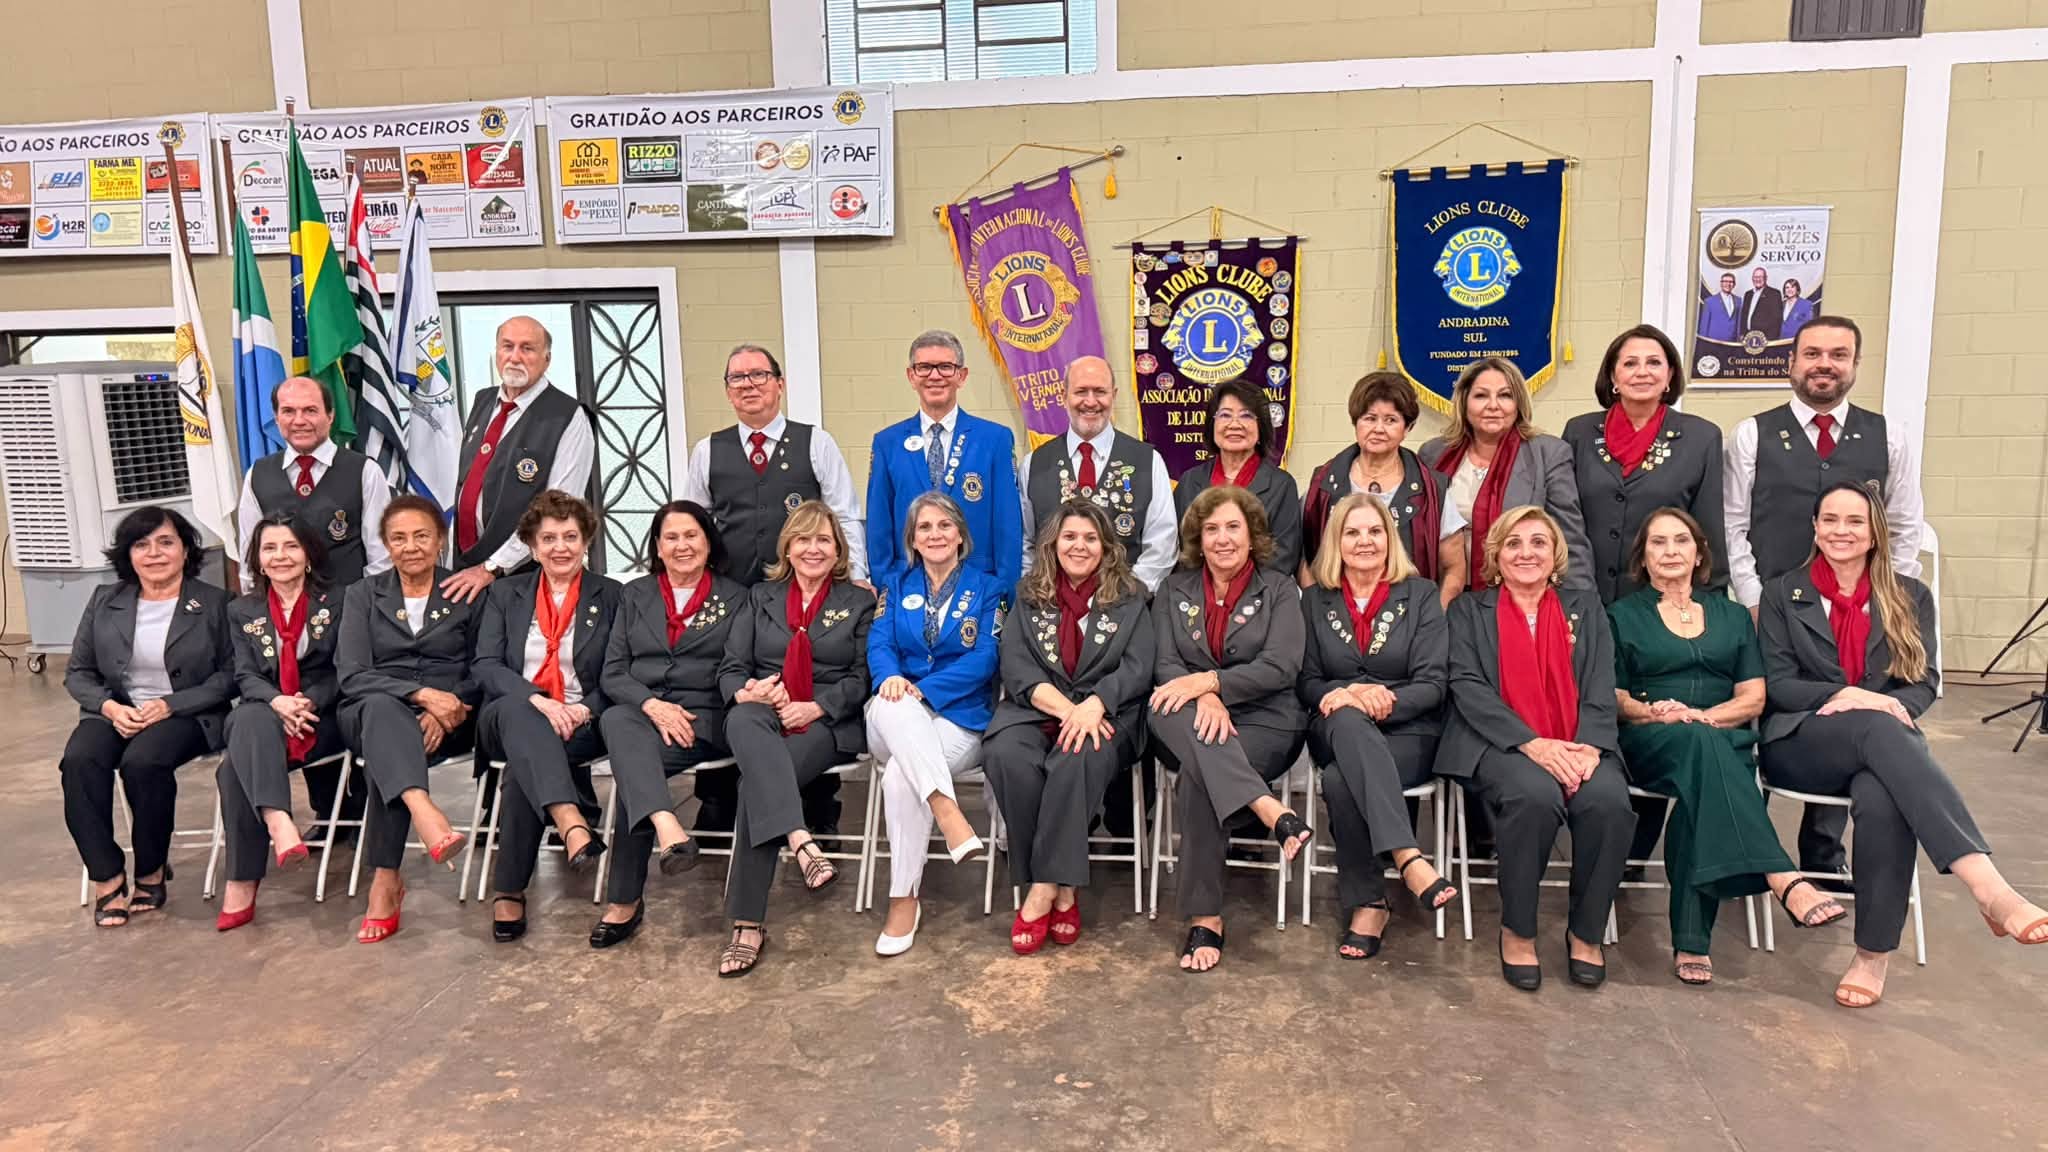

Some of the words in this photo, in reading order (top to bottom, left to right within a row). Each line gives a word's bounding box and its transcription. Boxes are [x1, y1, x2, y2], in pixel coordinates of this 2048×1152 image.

[570, 107, 667, 128] GRATIDÃO
[671, 109, 711, 124] AOS
[716, 104, 824, 123] PARCEIROS
[332, 125, 371, 140] AOS
[373, 119, 470, 138] PARCEIROS
[21, 138, 55, 152] AOS
[59, 132, 150, 150] PARCEIROS
[431, 153, 453, 161] CASA
[628, 144, 675, 159] RIZZO
[843, 146, 877, 163] PAF
[94, 159, 120, 169] FARMA
[121, 158, 137, 168] MEL
[363, 158, 401, 173] ATUAL
[569, 157, 609, 168] JUNIOR
[50, 171, 84, 186] BIA
[243, 174, 282, 187] Decorar
[312, 168, 340, 180] EGA
[364, 201, 398, 217] EIRÃO
[579, 198, 618, 209] EMPÓRIO
[589, 207, 620, 219] PEIXE
[1423, 201, 1472, 235] LIONS
[1477, 200, 1530, 230] CLUBE
[62, 220, 86, 231] H2R
[971, 207, 1046, 247] INTERNACIONAL
[1051, 218, 1079, 250] LIONS
[1775, 224, 1795, 232] COM
[1453, 230, 1503, 249] LIONS
[1763, 230, 1821, 245] RAÍZES
[1760, 250, 1821, 264] SERVIÇO
[995, 255, 1046, 282] LIONS
[1467, 252, 1491, 282] L
[1155, 265, 1209, 306] LIONS
[1216, 263, 1274, 304] CLUBE
[1454, 286, 1502, 303] INTERNATIONAL
[1011, 282, 1048, 323] L
[1184, 292, 1245, 315] LIONS
[1438, 316, 1510, 329] ANDRADINA
[1004, 319, 1064, 343] INTERNATIONAL
[1202, 319, 1229, 353] L
[1463, 332, 1488, 343] SUL
[1429, 350, 1467, 359] FUNDADO
[1469, 350, 1481, 358] EM
[1727, 356, 1786, 366] Construindo
[1184, 361, 1243, 379] INTERNATIONAL
[1737, 367, 1766, 376] Trilha
[1032, 394, 1066, 412] 94-9
[1140, 385, 1201, 407] ASSOCIAÇÃO
[1167, 411, 1181, 426] DE
[1184, 411, 1206, 426] LION
